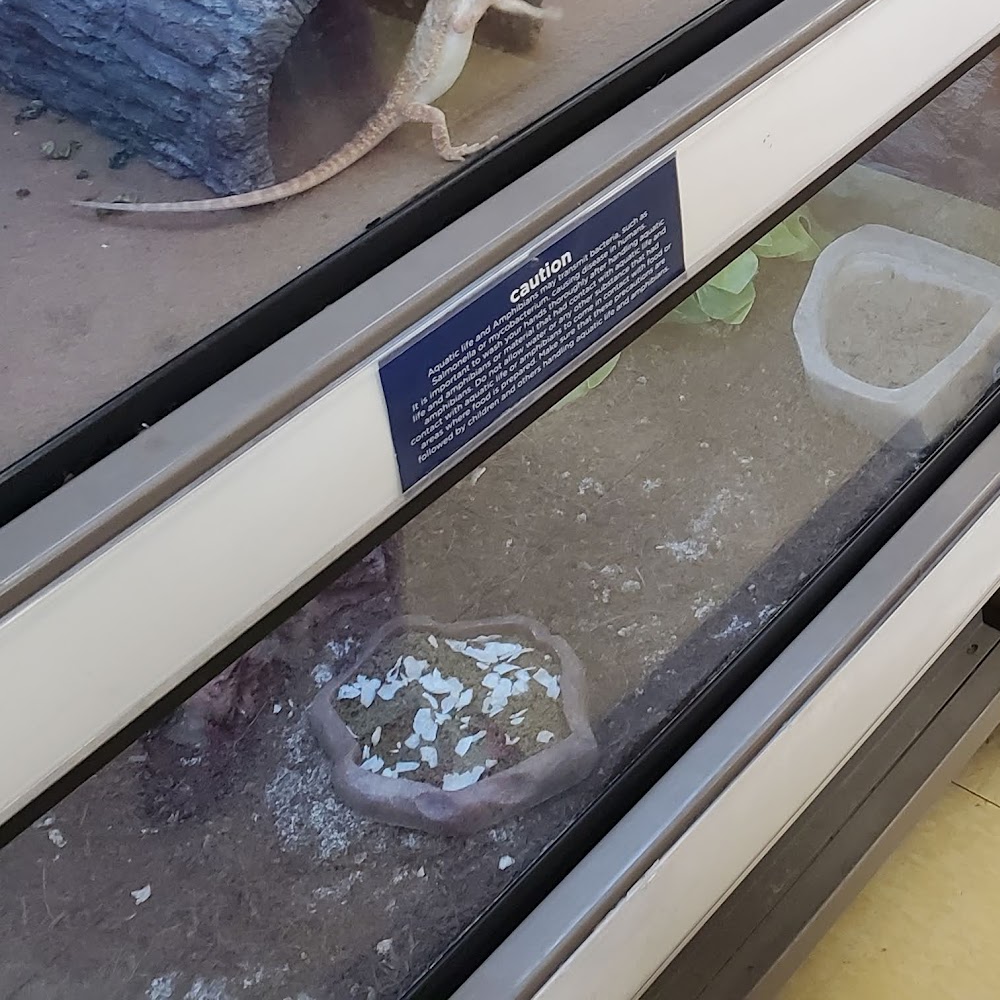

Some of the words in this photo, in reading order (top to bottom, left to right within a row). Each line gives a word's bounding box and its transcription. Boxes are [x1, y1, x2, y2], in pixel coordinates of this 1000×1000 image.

[410, 418, 442, 445] contact
[444, 403, 462, 420] with
[464, 379, 494, 406] aquatic
[495, 369, 507, 382] life
[519, 327, 561, 363] amphibians
[573, 304, 593, 322] come
[603, 275, 629, 299] contact
[630, 263, 646, 277] with
[646, 248, 662, 265] food
[412, 409, 425, 422] life
[427, 394, 443, 411] and
[445, 360, 491, 398] amphibians
[503, 326, 534, 354] material
[535, 314, 551, 329] that
[552, 301, 567, 317] had
[568, 280, 596, 304] contact
[597, 268, 613, 282] with
[614, 247, 640, 270] aquatic
[641, 238, 652, 250] life
[652, 226, 666, 241] and
[417, 431, 453, 463] followed
[454, 423, 465, 435] by
[467, 398, 499, 425] children
[500, 384, 515, 400] and
[517, 365, 541, 387] others
[542, 339, 574, 367] handling
[575, 318, 602, 342] aquatic
[603, 308, 614, 320] life
[615, 295, 629, 310] and
[630, 266, 669, 299] amphibians.
[420, 428, 443, 449] areas
[445, 408, 470, 430] where
[472, 391, 491, 410] food
[500, 357, 537, 389] prepared.
[538, 341, 558, 359] Make
[559, 328, 575, 343] sure
[576, 314, 591, 329] that
[593, 299, 613, 317] these
[614, 267, 653, 302] precautions
[654, 257, 665, 269] are
[424, 386, 473, 424] amphibians.
[474, 374, 487, 387] Do
[488, 362, 501, 376] not
[503, 346, 524, 365] allow
[525, 328, 547, 348] water
[558, 309, 572, 323] any
[573, 293, 593, 312] other
[594, 266, 629, 296] substance
[630, 253, 645, 268] that
[645, 241, 659, 256] had
[427, 349, 459, 377] Aquatic
[460, 339, 473, 352] life
[475, 324, 490, 342] and
[492, 291, 538, 329] Amphibians
[539, 278, 556, 294] may
[557, 254, 588, 280] transmit
[589, 232, 620, 257] bacteria,
[621, 217, 638, 233] such
[429, 364, 469, 398] important
[481, 340, 502, 358] wash
[503, 325, 522, 344] your
[523, 307, 547, 328] hands
[548, 276, 588, 309] thoroughly
[589, 262, 607, 279] after
[607, 238, 638, 264] handling
[639, 218, 664, 241] aquatic
[431, 349, 476, 385] Salmonella
[488, 295, 550, 343] mycobacterium,
[551, 271, 580, 296] causing
[581, 251, 608, 274] disease
[617, 223, 646, 247] humans.
[509, 251, 571, 302] caution
